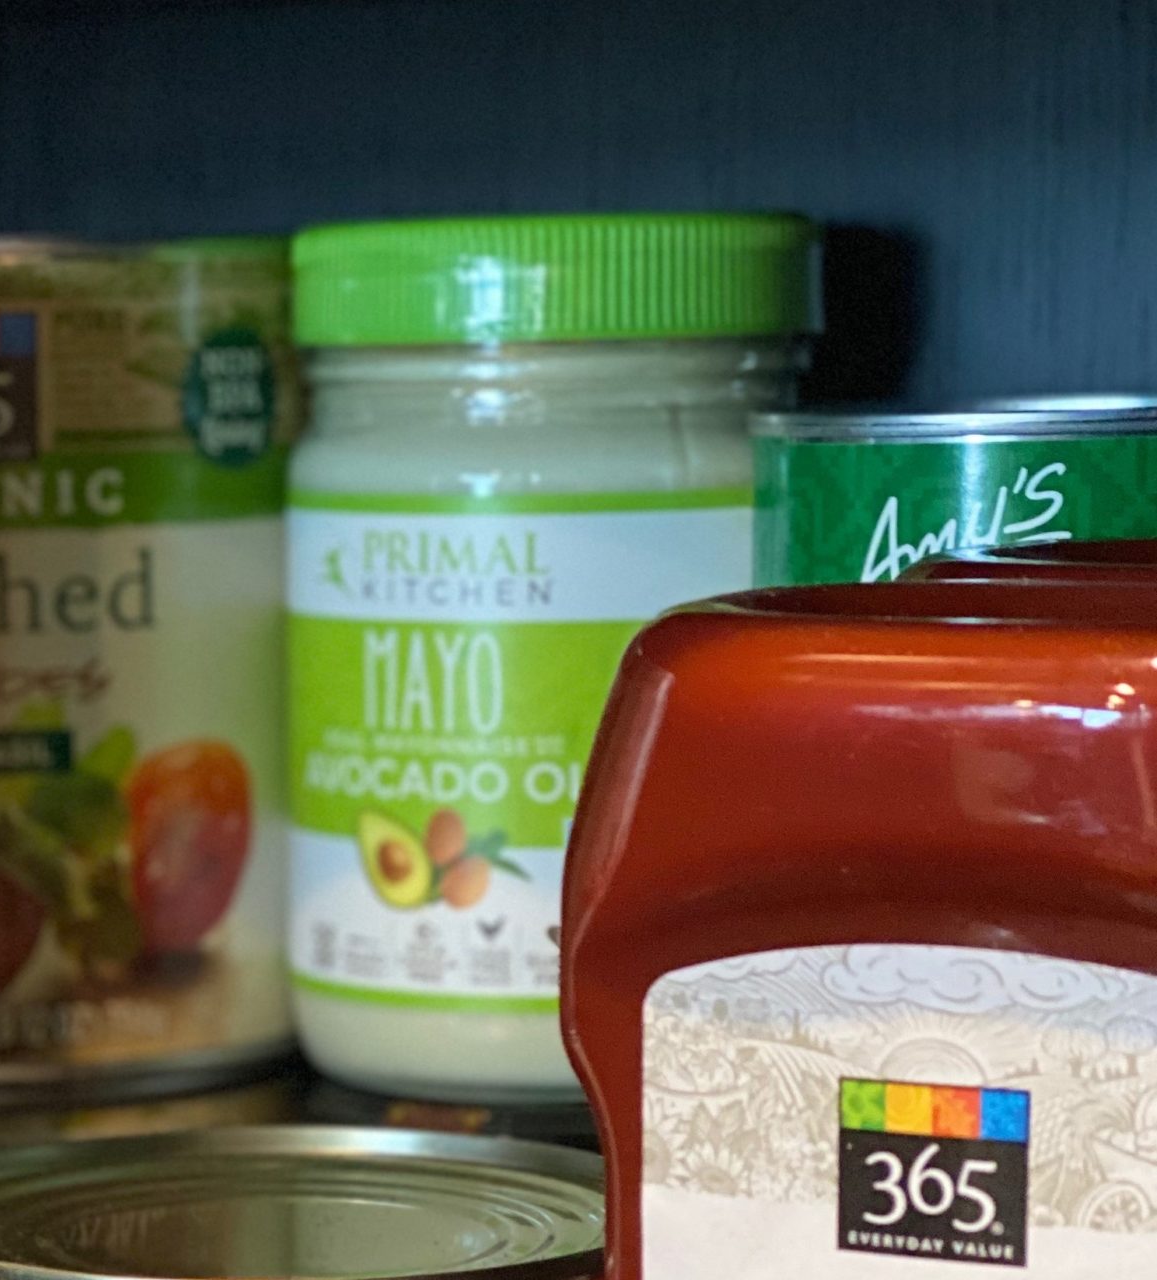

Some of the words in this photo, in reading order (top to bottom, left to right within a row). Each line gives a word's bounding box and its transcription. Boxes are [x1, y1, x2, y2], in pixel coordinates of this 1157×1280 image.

[361, 529, 550, 576] PRIMAL
[360, 576, 554, 606] KITCHEN
[361, 630, 505, 735] MAYO
[304, 751, 511, 804] AVOCADO
[523, 761, 582, 804] OI
[848, 1230, 945, 1254] EVERYDAY
[952, 1239, 1015, 1261] VALUE
